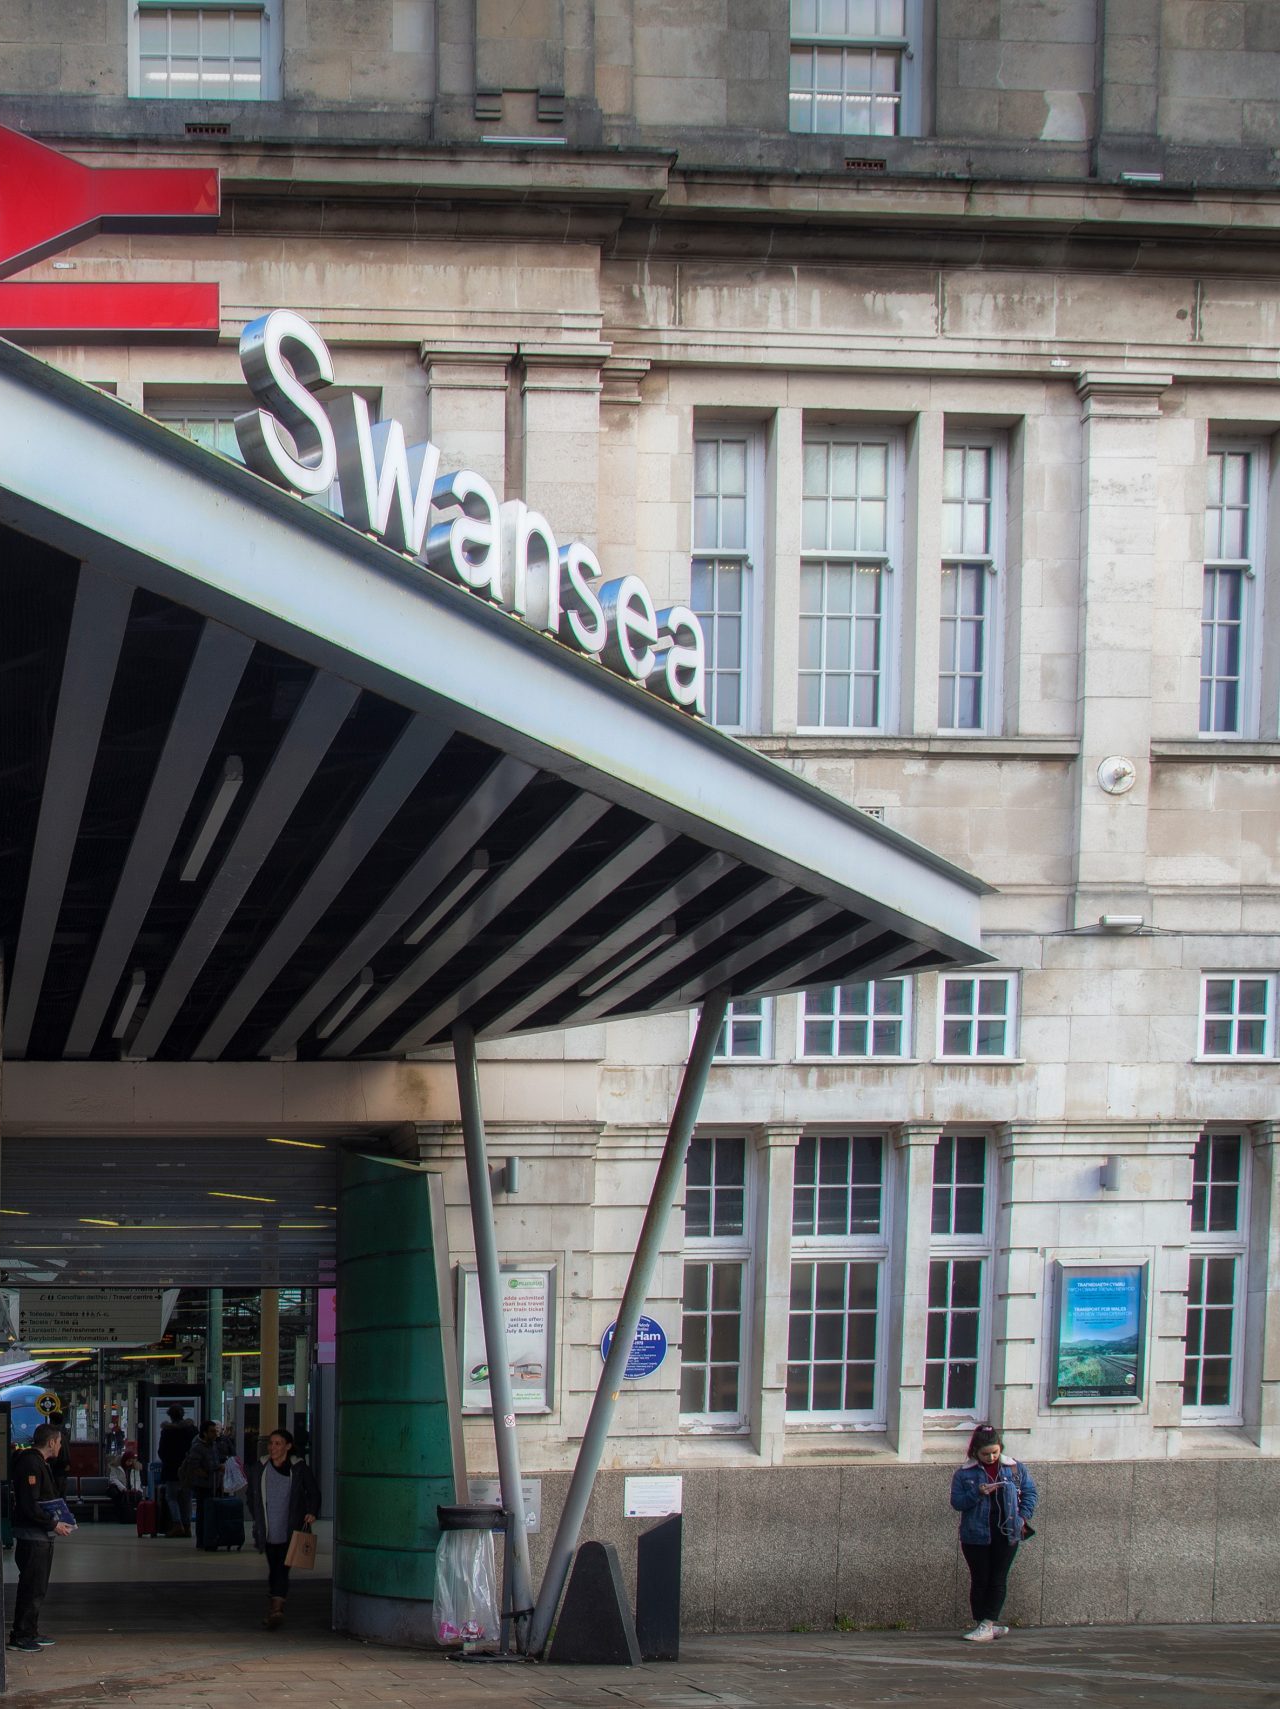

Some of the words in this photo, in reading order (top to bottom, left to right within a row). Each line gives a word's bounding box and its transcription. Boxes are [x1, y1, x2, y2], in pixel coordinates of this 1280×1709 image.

[233, 308, 706, 718] Swansea
[634, 1331, 661, 1341] Ham
[181, 1346, 194, 1363] 2
